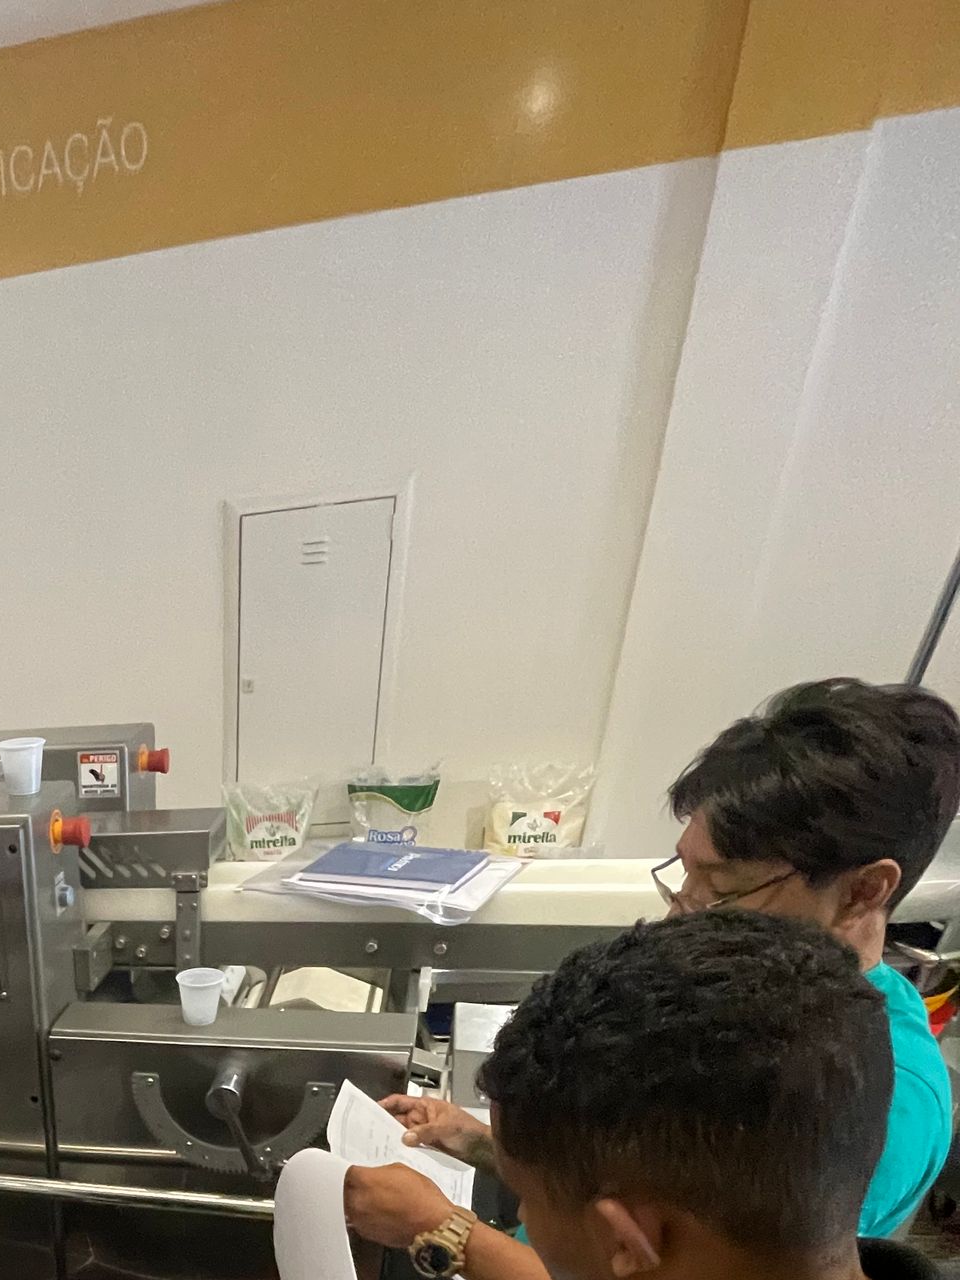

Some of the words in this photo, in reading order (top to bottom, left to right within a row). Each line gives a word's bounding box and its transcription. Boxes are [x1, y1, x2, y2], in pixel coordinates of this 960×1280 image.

[250, 835, 297, 850] mirella
[368, 830, 401, 842] Rosa
[507, 831, 557, 844] mirella
